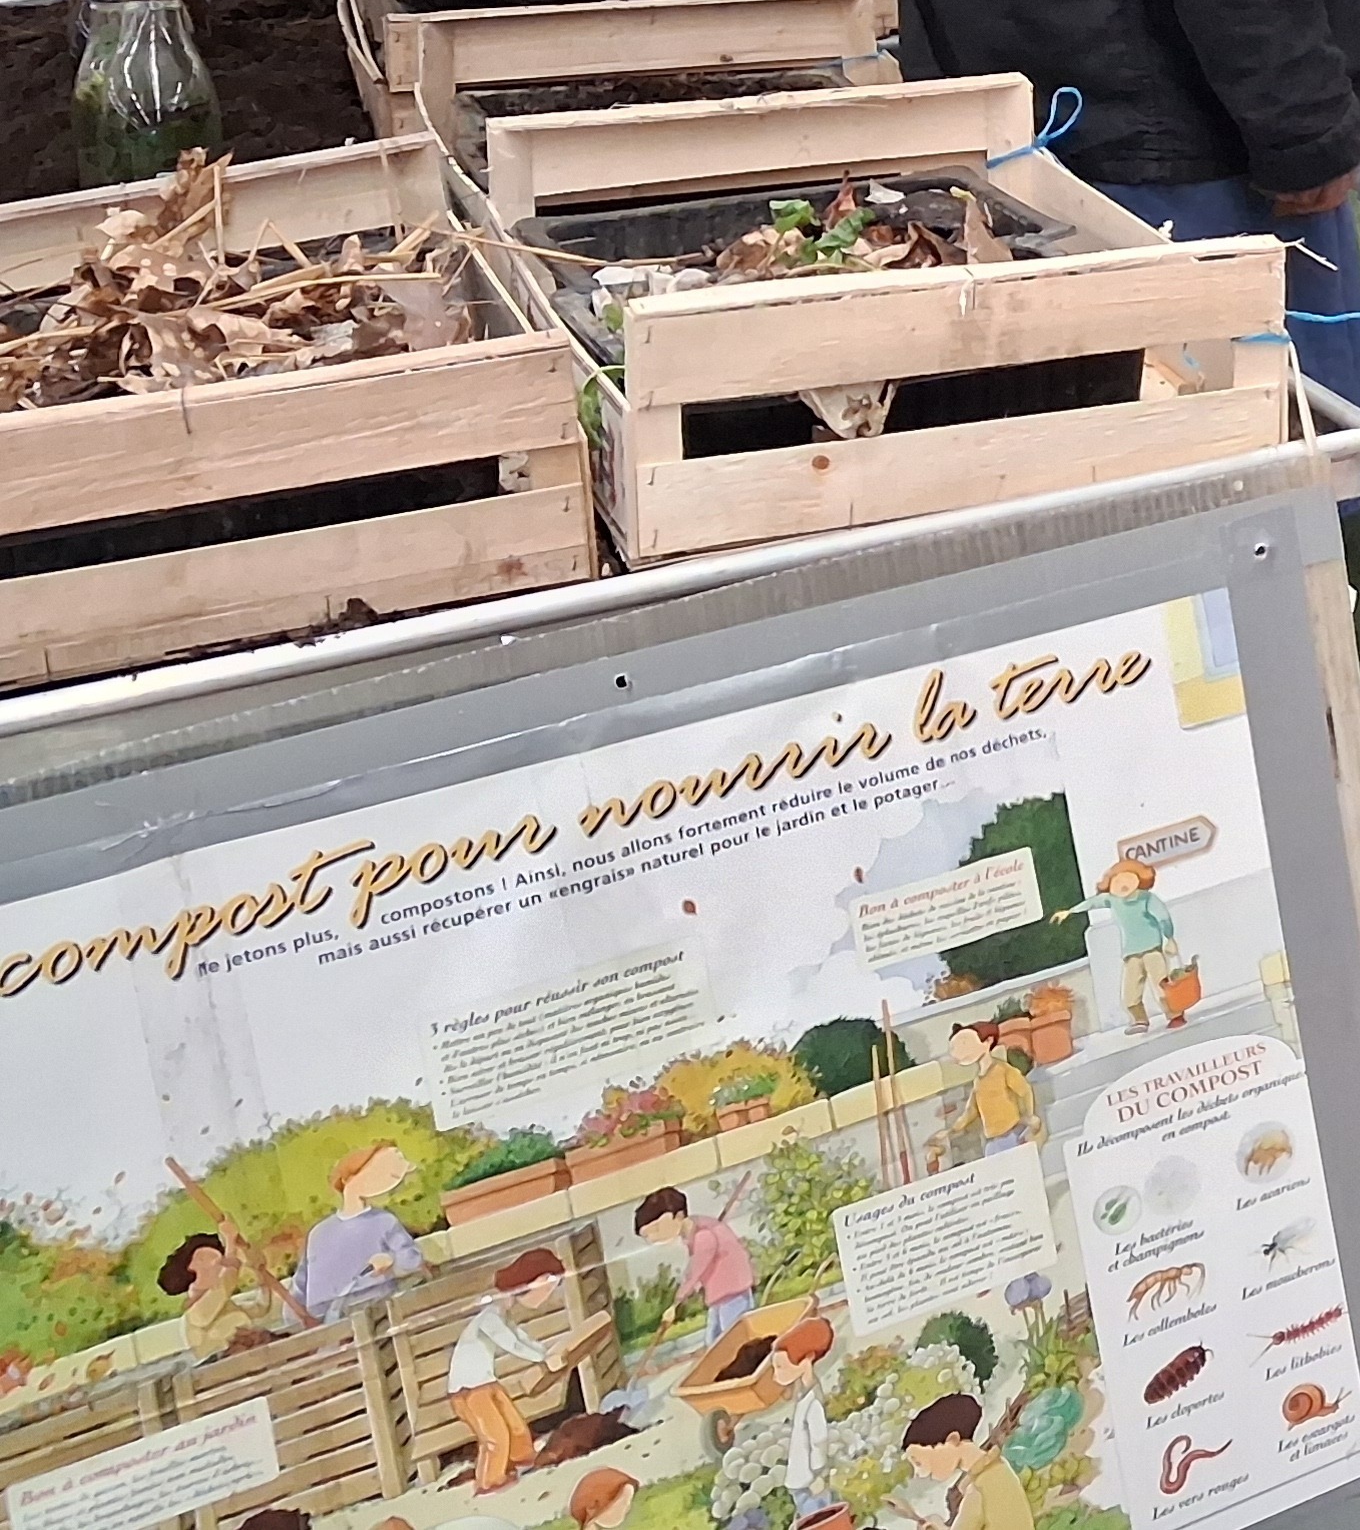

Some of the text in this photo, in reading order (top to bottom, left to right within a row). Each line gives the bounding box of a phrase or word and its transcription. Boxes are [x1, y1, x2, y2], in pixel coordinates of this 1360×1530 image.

[0, 650, 1153, 998] compost pour nourrir la terre
[1124, 826, 1202, 861] CANTINE
[225, 940, 287, 973] jetons
[292, 929, 340, 954] plus,
[381, 883, 496, 926] compostons
[515, 862, 568, 889] Ainsi,
[572, 851, 616, 873] nous
[621, 831, 673, 859] allons
[678, 804, 767, 841] fortement
[771, 786, 834, 814] réduire
[838, 780, 854, 796] le
[858, 762, 920, 790] volume
[925, 755, 946, 772] de
[950, 746, 978, 765] nos
[981, 726, 1049, 755] déchets,
[318, 932, 363, 965] mais
[368, 923, 417, 952] aussi
[422, 901, 513, 935] récupérer
[518, 892, 543, 909] un
[549, 867, 635, 902] «engrais»
[640, 843, 705, 872] naturel
[709, 833, 750, 856] pour
[755, 823, 772, 840] le
[775, 807, 826, 837] jardin
[831, 803, 849, 819] et
[853, 796, 868, 812] le
[858, 902, 886, 919] Bon
[903, 878, 970, 906] composter
[443, 1011, 491, 1034] règles
[494, 1000, 532, 1024] pour
[535, 978, 590, 1007] réussir
[592, 971, 620, 988] son
[623, 950, 685, 978] compost
[1106, 1042, 1268, 1108] LES TRAVAILLEURS
[1117, 1059, 1264, 1124] DU COMPOST
[1096, 1114, 1174, 1151] décomposent
[1177, 1106, 1195, 1122] les
[1161, 1129, 1177, 1143] en
[844, 1172, 976, 1228] Usages du compost
[1235, 1177, 1311, 1212] Les acariens
[1107, 1229, 1206, 1274] et champignons
[1115, 1219, 1195, 1257] Les bactéries
[1241, 1286, 1263, 1302] Les
[1122, 1302, 1218, 1349] Les collemboles
[1265, 1366, 1287, 1382] Les
[1145, 1390, 1226, 1431] Les cloportes
[1278, 1438, 1300, 1454] Les
[1289, 1430, 1349, 1463] et limaces
[1152, 1473, 1250, 1522] Les vers rouges
